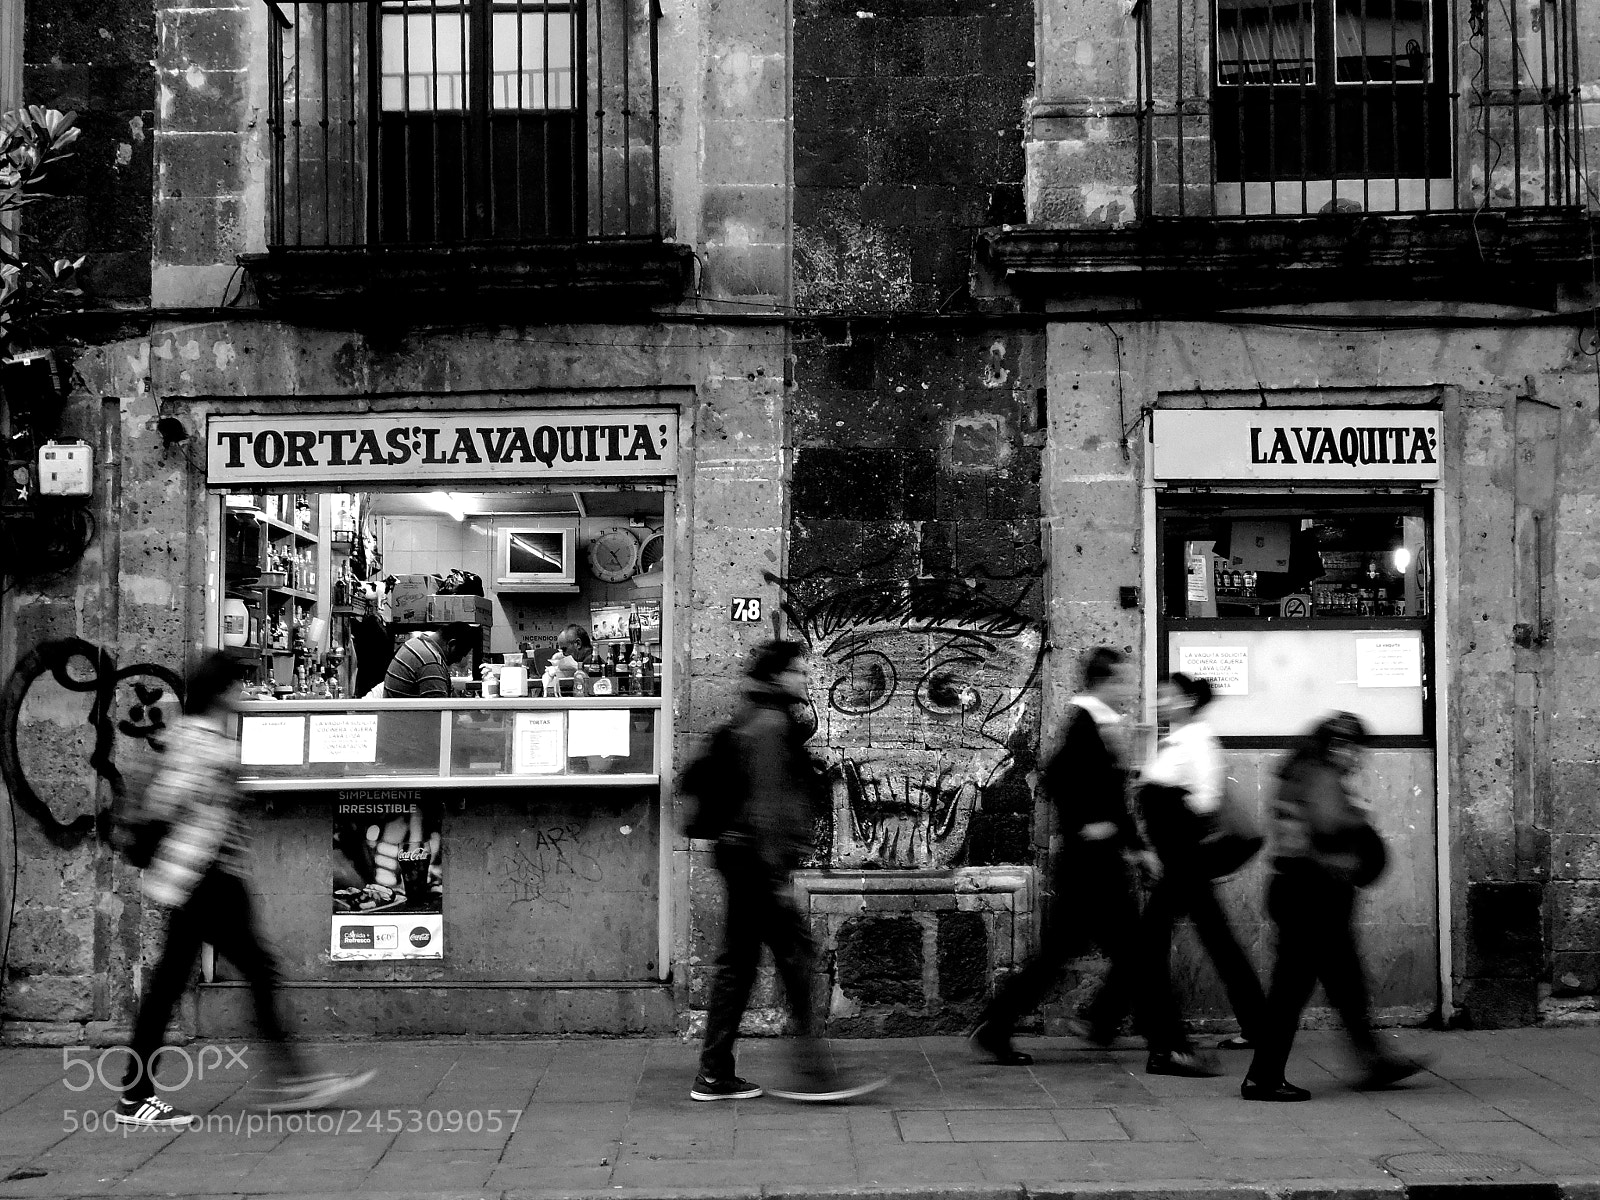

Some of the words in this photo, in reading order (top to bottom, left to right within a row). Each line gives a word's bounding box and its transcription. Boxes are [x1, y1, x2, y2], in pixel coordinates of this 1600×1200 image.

[217, 427, 411, 469] TORTAS
[733, 598, 760, 620] 78
[339, 790, 421, 800] SIMPLEMENTE
[339, 804, 417, 813] IRRESISTIBLE
